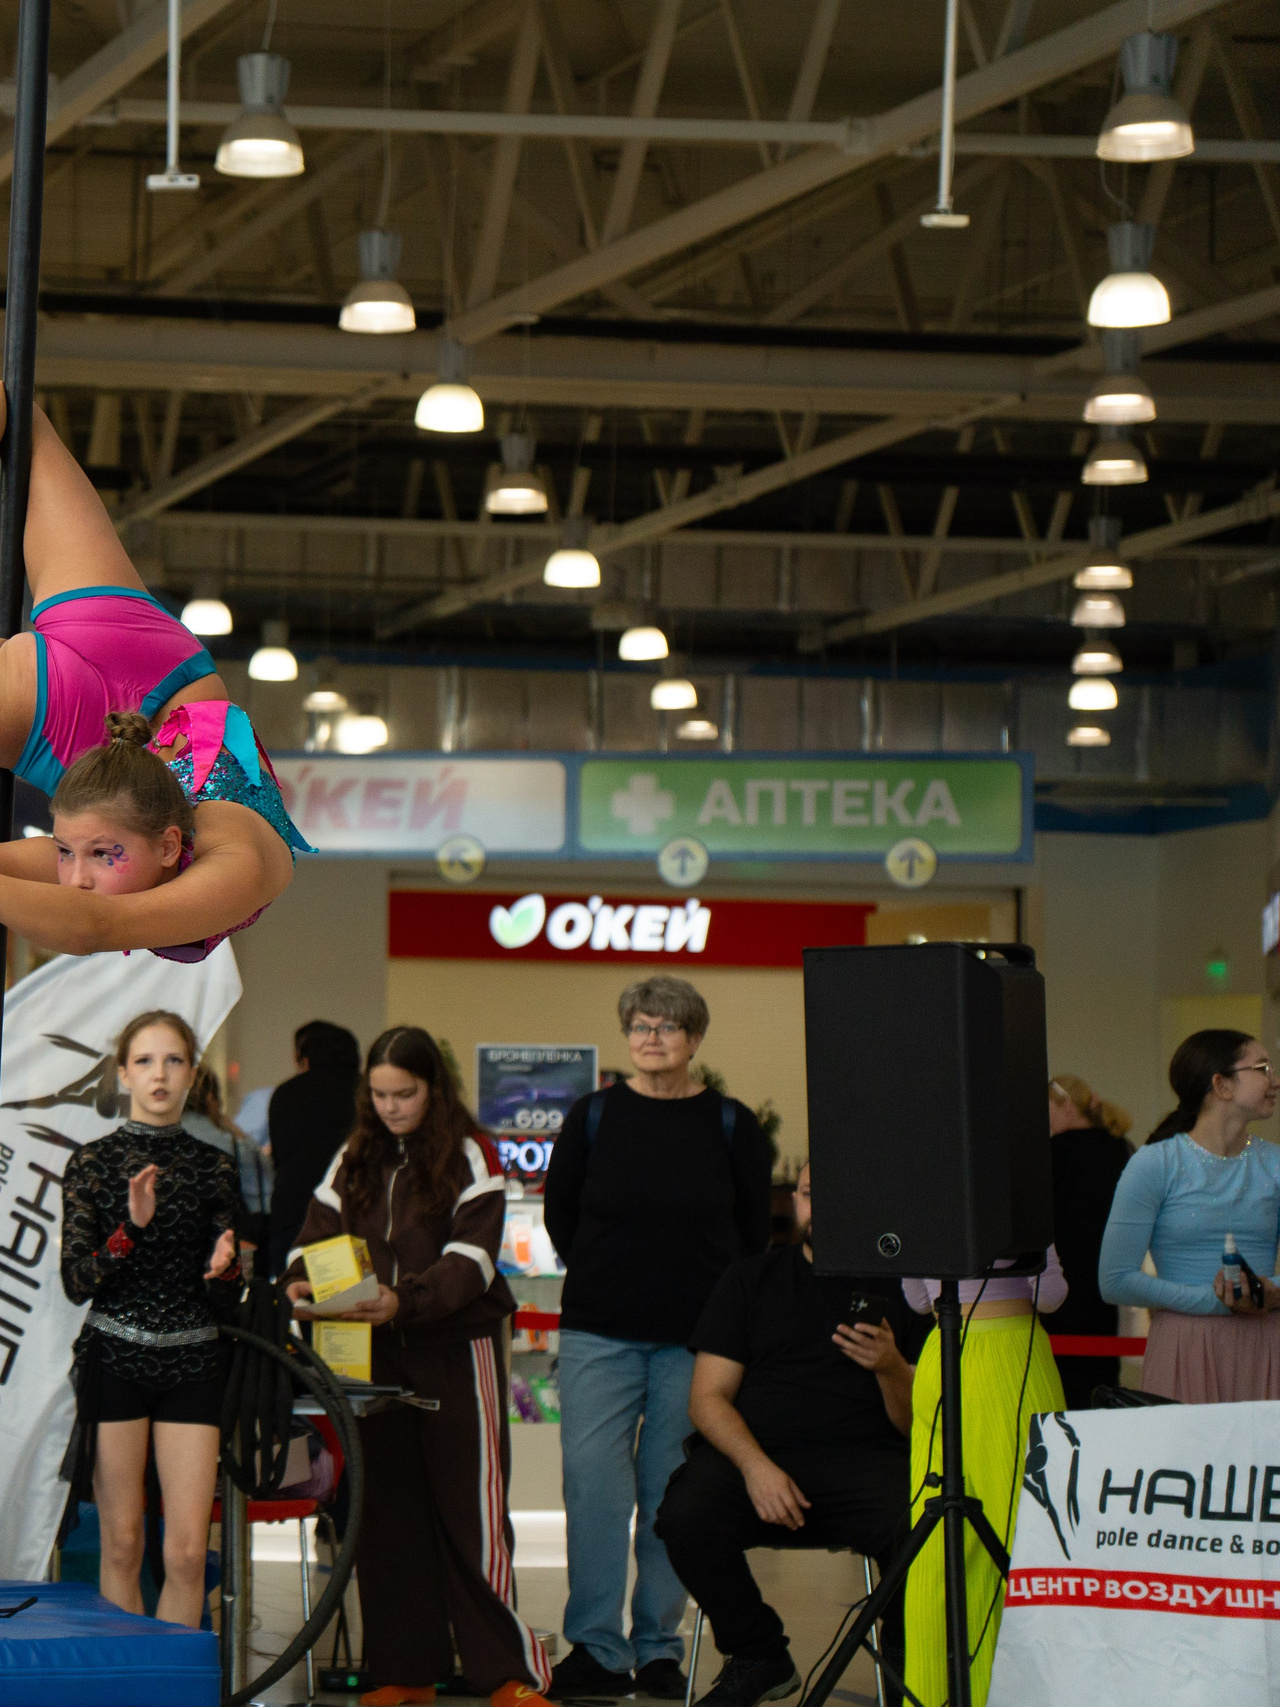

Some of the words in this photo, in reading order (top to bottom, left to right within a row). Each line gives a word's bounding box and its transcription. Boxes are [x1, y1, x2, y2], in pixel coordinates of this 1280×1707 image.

[698, 779, 962, 827] АПТЕКА
[515, 1109, 565, 1130] 699
[1096, 1527, 1138, 1549] pole
[1147, 1529, 1223, 1553] dance
[1230, 1534, 1245, 1554] &
[1009, 1577, 1100, 1599] ЦЕНТР
[1105, 1580, 1280, 1609] ВОЗДУШН
